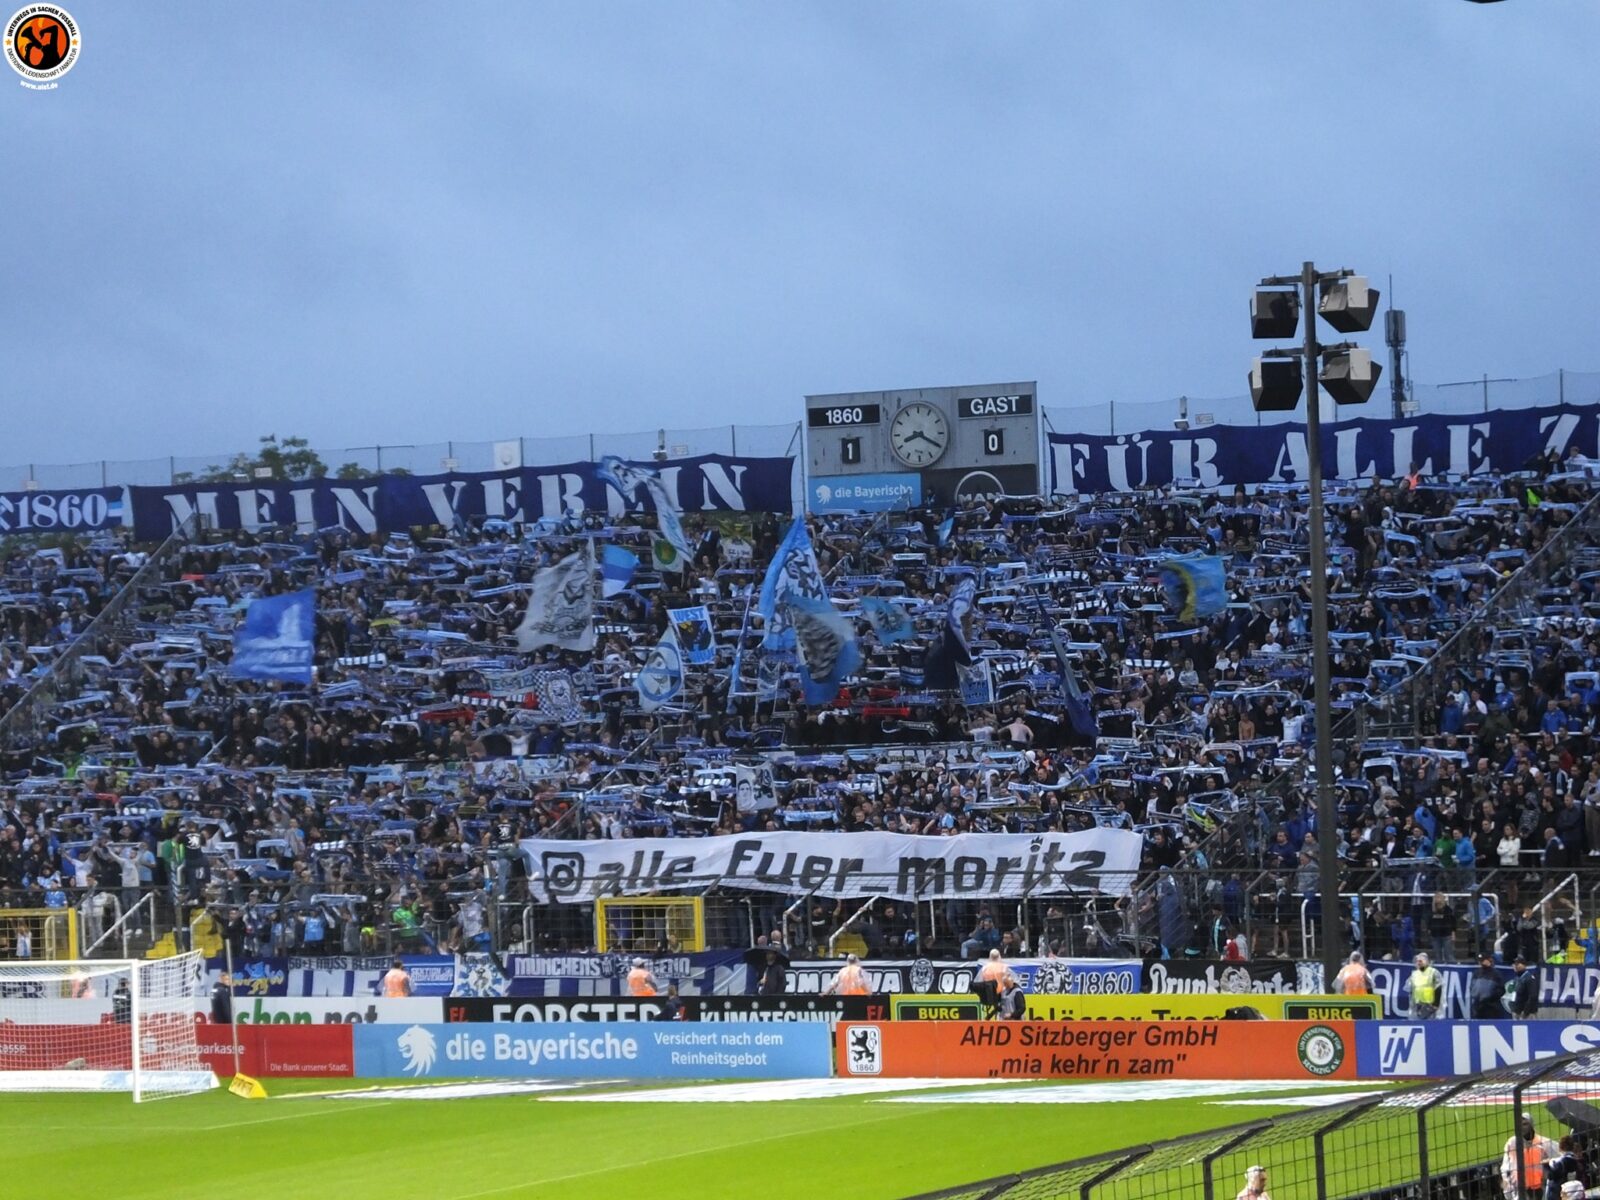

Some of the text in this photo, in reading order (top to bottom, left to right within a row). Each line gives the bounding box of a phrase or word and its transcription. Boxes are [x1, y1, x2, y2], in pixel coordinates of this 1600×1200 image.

[825, 396, 1019, 424] 1860 GAST
[846, 442, 853, 460] 1
[988, 435, 998, 452] 0
[163, 486, 379, 536] MEIN
[1050, 433, 1224, 496] FÜR
[1268, 422, 1491, 483] ALLE
[834, 483, 913, 503] die Bayerische
[515, 954, 600, 977] MÜNCHENS
[1075, 971, 1134, 994] 1860
[918, 1007, 960, 1020] BURG
[1308, 1008, 1352, 1020] BURG
[654, 1032, 783, 1046] Versichert nach dem
[960, 1025, 1219, 1051] AHD Sitzberger GmbH
[446, 1032, 638, 1066] die Bayerische
[270, 1063, 349, 1072] Die Bank unserer Stadt.
[671, 1051, 767, 1068] Reinheitsgebot
[855, 1064, 875, 1072] 1860
[1302, 1058, 1331, 1075] SECHZIG
